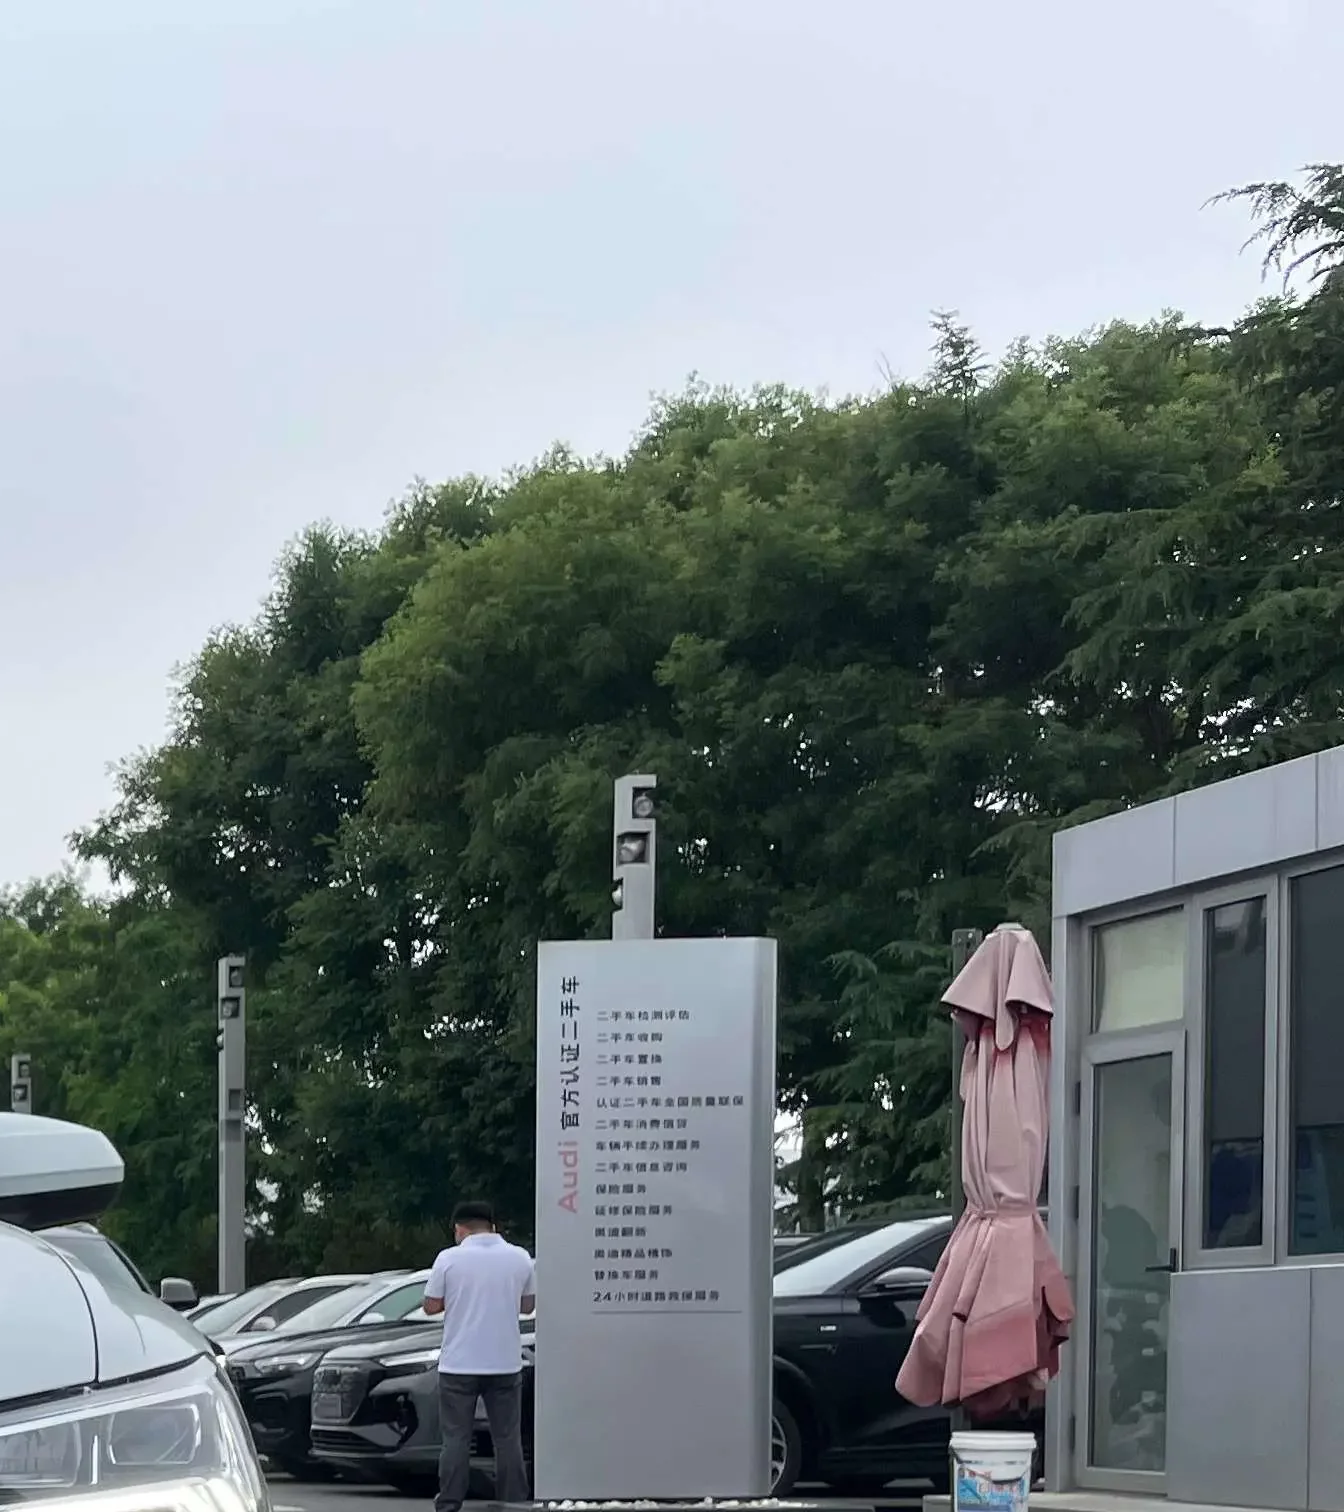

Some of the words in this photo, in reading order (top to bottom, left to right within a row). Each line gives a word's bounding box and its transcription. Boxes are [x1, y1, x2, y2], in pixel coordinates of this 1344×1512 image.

[560, 975, 581, 1131] 官方认证二手车
[557, 1140, 579, 1214] Audi
